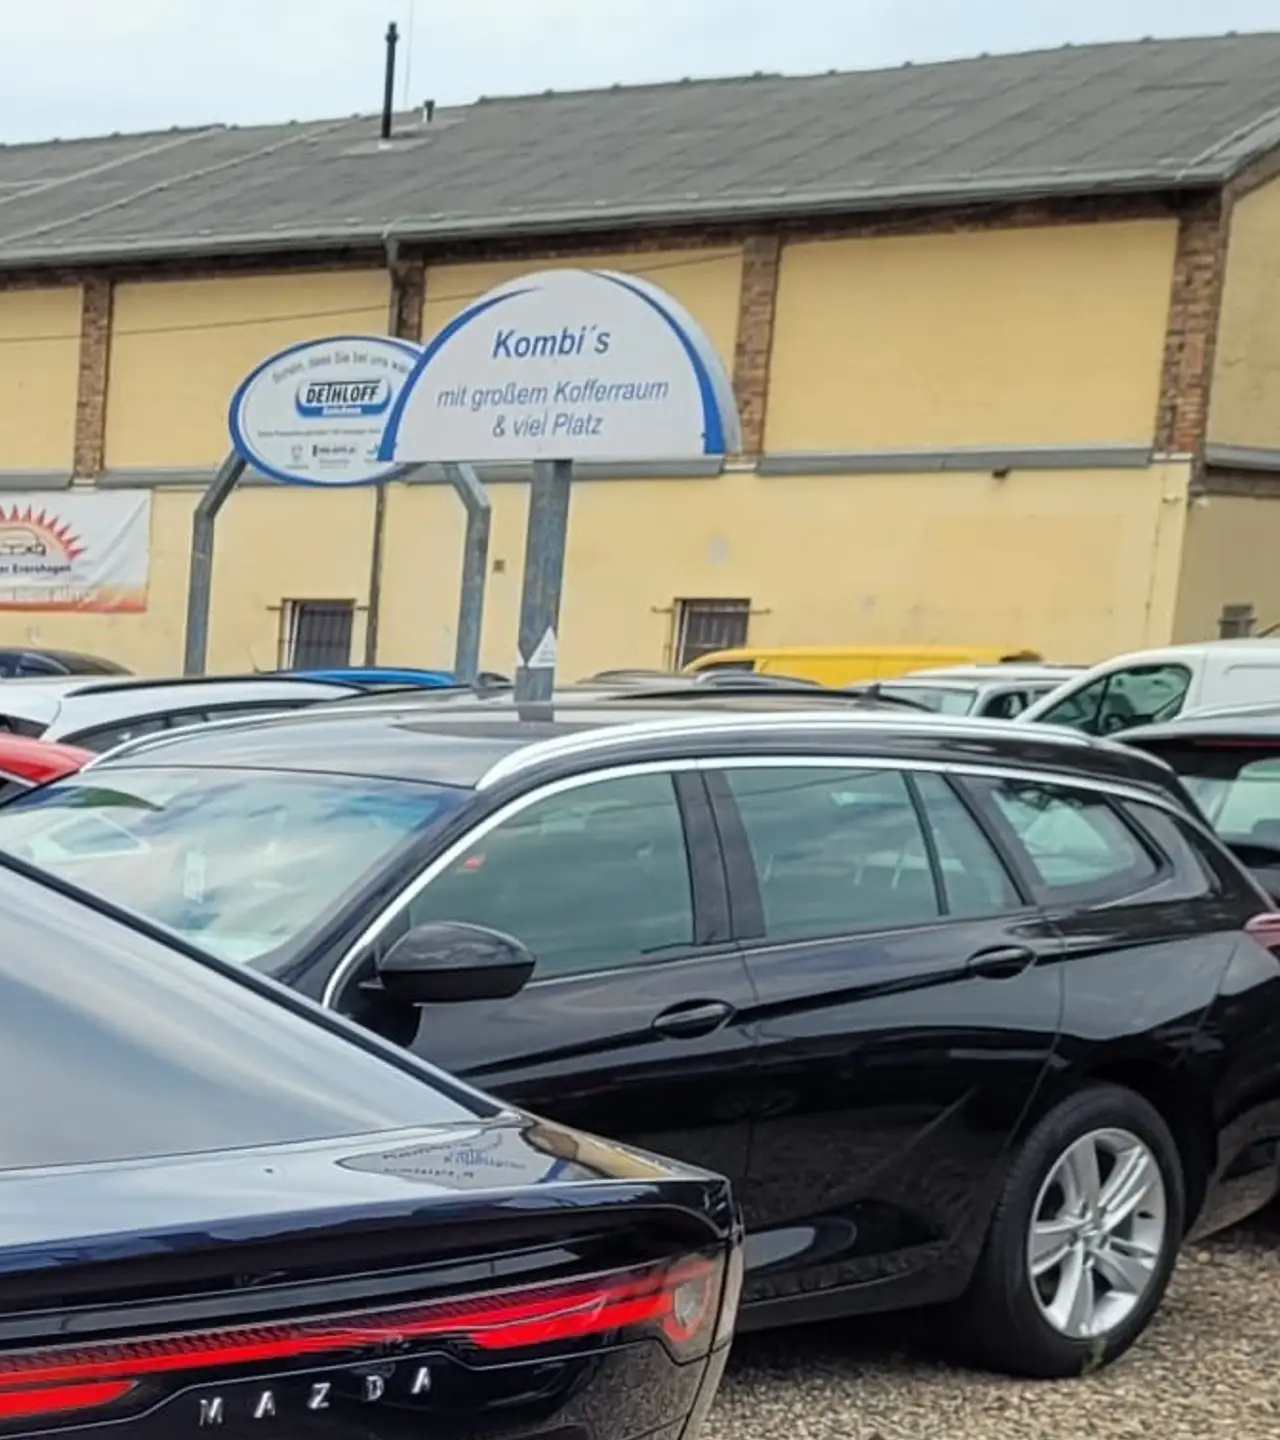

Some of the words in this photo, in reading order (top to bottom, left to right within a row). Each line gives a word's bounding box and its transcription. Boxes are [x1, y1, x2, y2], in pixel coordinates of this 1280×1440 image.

[306, 379, 383, 404] DETHLOFF
[437, 382, 468, 408] mit
[471, 381, 548, 412] großem
[553, 378, 670, 405] Kofferraum
[492, 414, 506, 438] &
[513, 408, 547, 437] viel
[552, 412, 604, 436] Platz
[199, 1366, 432, 1427] MAZDA
